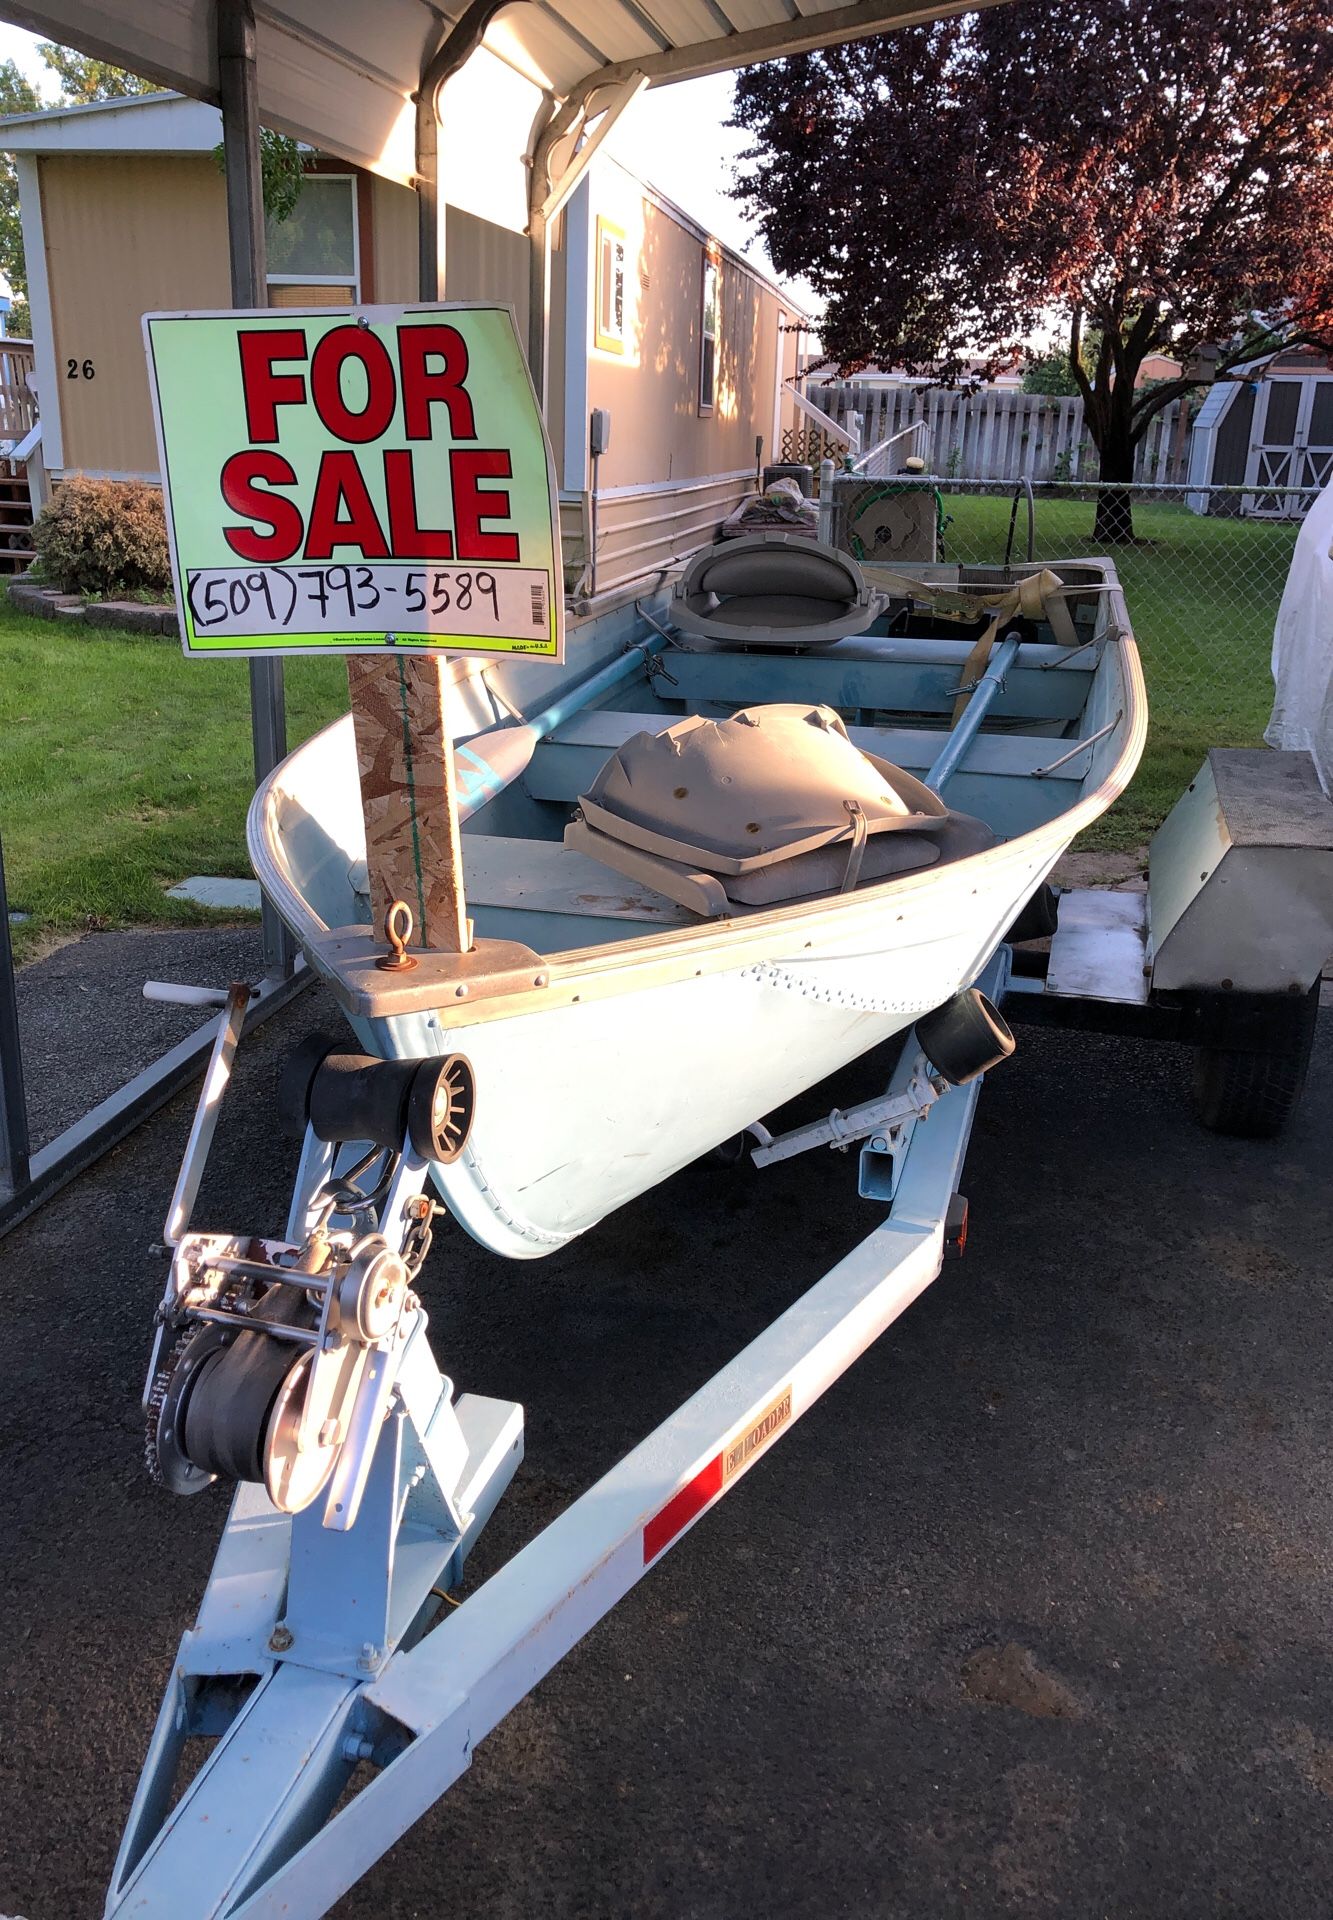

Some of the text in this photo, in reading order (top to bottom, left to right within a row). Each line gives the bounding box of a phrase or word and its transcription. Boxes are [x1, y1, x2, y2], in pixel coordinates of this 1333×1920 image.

[67, 358, 95, 380] 26
[237, 323, 478, 444] FOR
[220, 448, 520, 563] SALE
